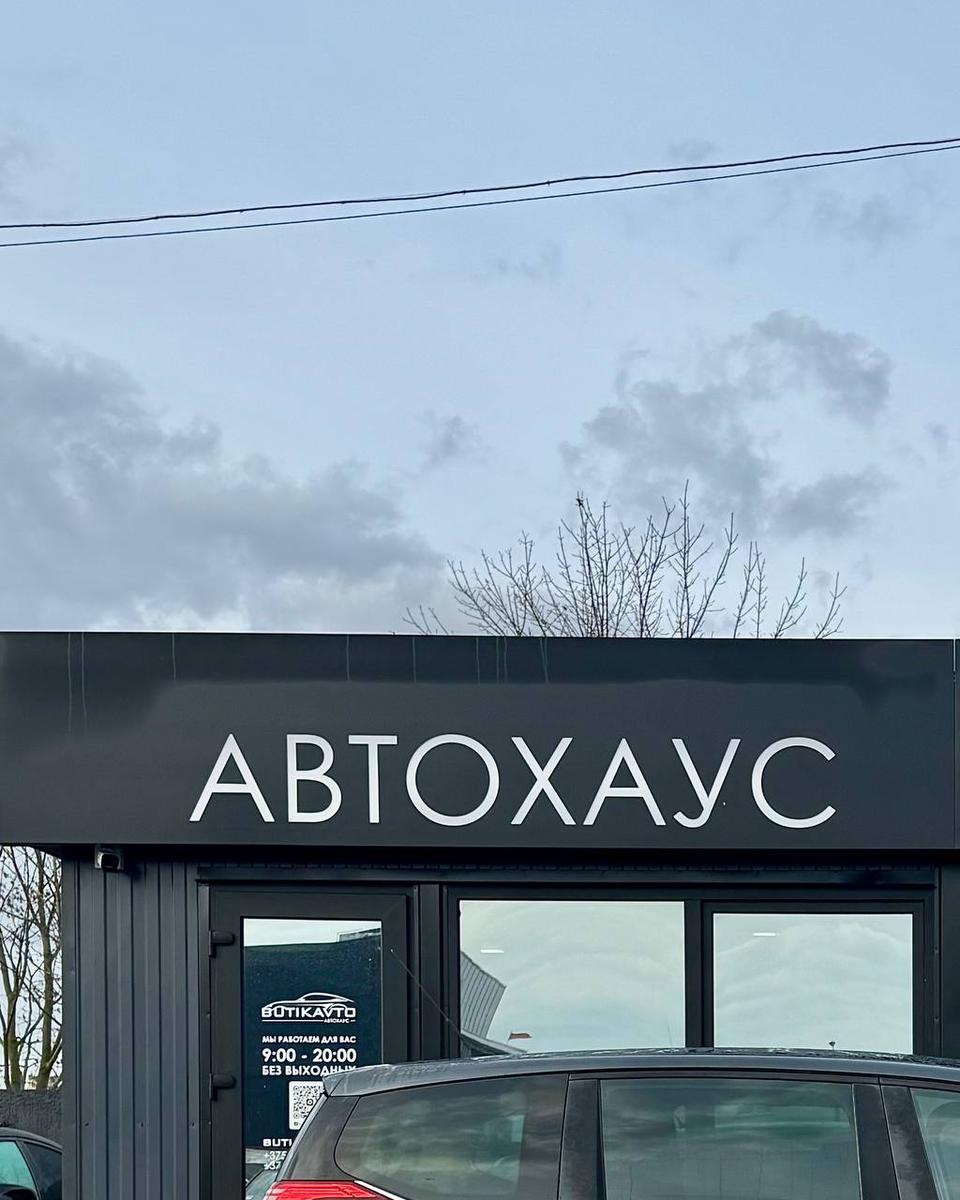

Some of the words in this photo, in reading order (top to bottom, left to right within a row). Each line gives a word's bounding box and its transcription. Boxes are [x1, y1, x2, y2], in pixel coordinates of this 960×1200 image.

[188, 733, 837, 830] АВТОХАУС
[261, 1007, 356, 1018] BUTIKAVTO
[321, 1036, 338, 1044] ДЛЯ
[262, 1048, 296, 1062] 9:00
[312, 1048, 357, 1062] 20:00
[262, 1066, 282, 1075] БЕЗ
